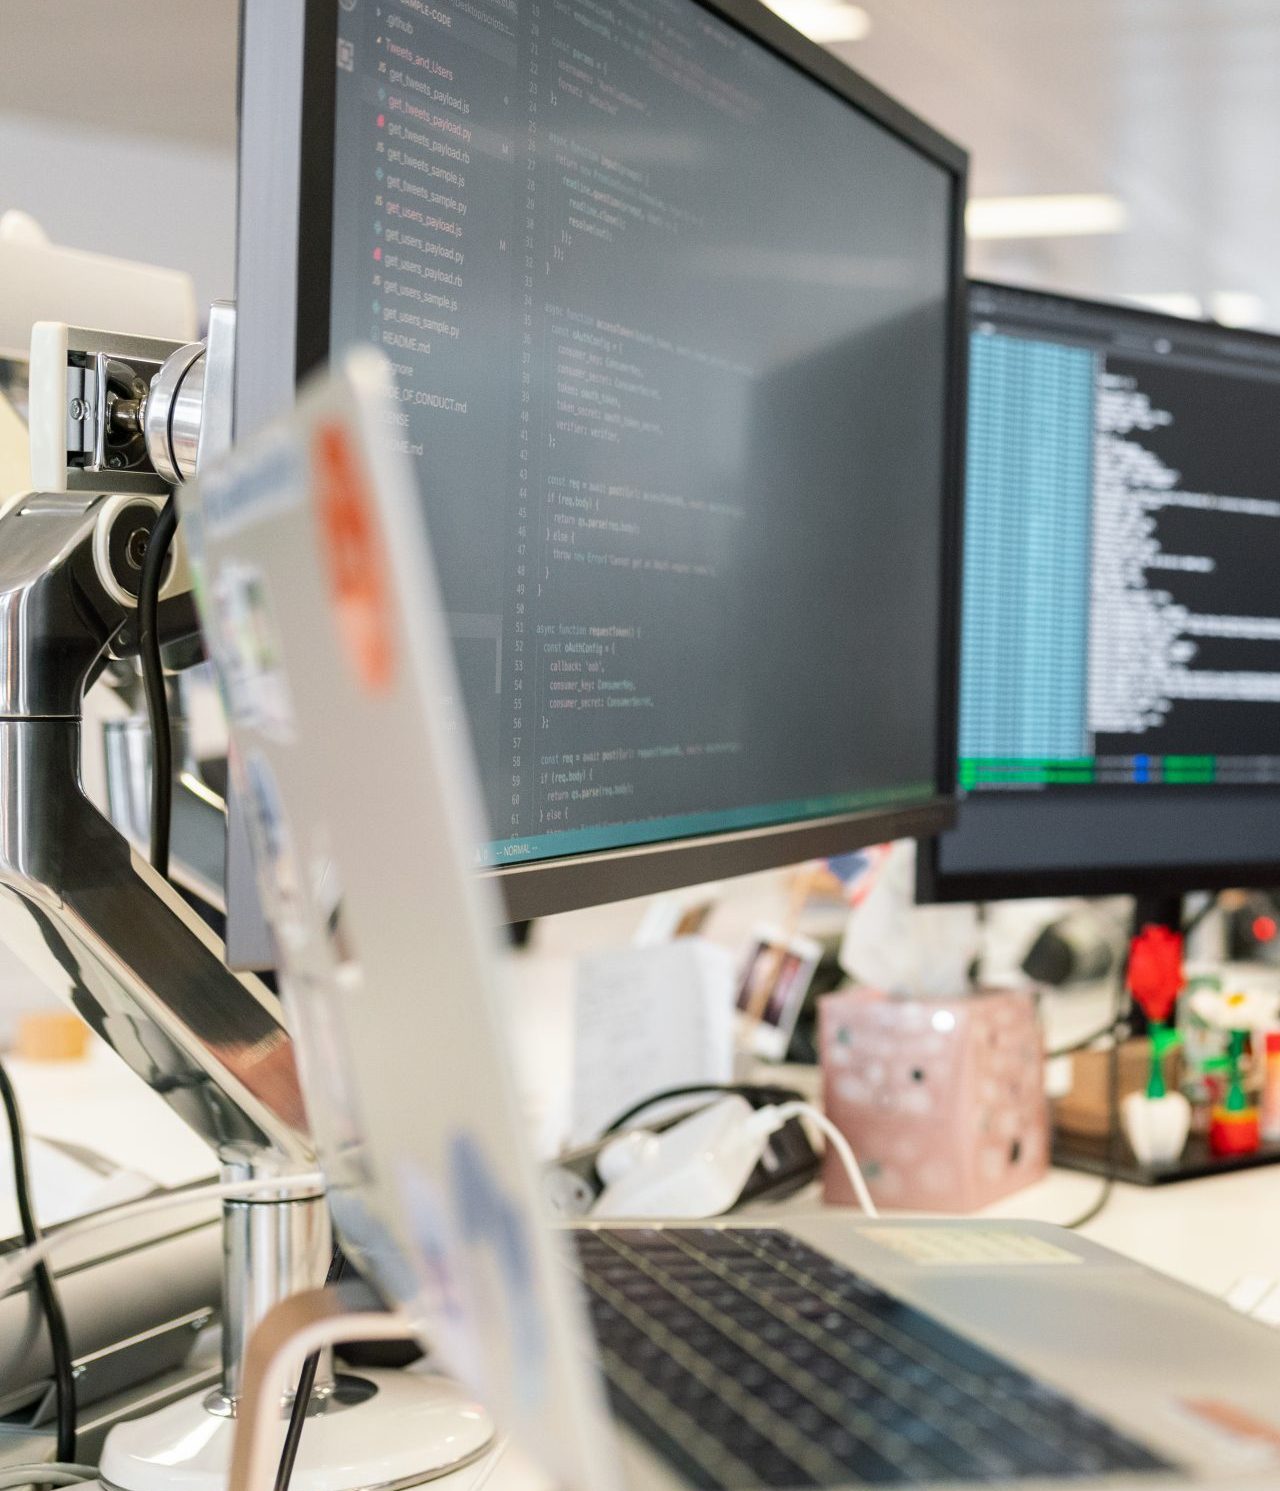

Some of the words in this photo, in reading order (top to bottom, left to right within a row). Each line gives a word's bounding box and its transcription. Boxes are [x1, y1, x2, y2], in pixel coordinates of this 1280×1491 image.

[401, 0, 452, 28] MPLE-CODE
[385, 37, 453, 80] Tweets_and_Users
[389, 70, 470, 114] get_tweets_payload.js
[388, 96, 472, 143] get_tweets_payload.py
[388, 122, 470, 164] get_tweets_payload.rb
[387, 148, 464, 189] get_tweets_sample.js
[386, 176, 467, 216] get_tweets_sample.py
[385, 201, 463, 239] get_users_payload.js
[384, 228, 464, 266] get_users_payload.py
[384, 254, 462, 288] get_users_payload.rb
[383, 281, 458, 313] get_users_sample.js
[382, 331, 431, 354] README.md
[383, 307, 460, 340] get_users_sample.py
[503, 844, 531, 857] NORMAL
